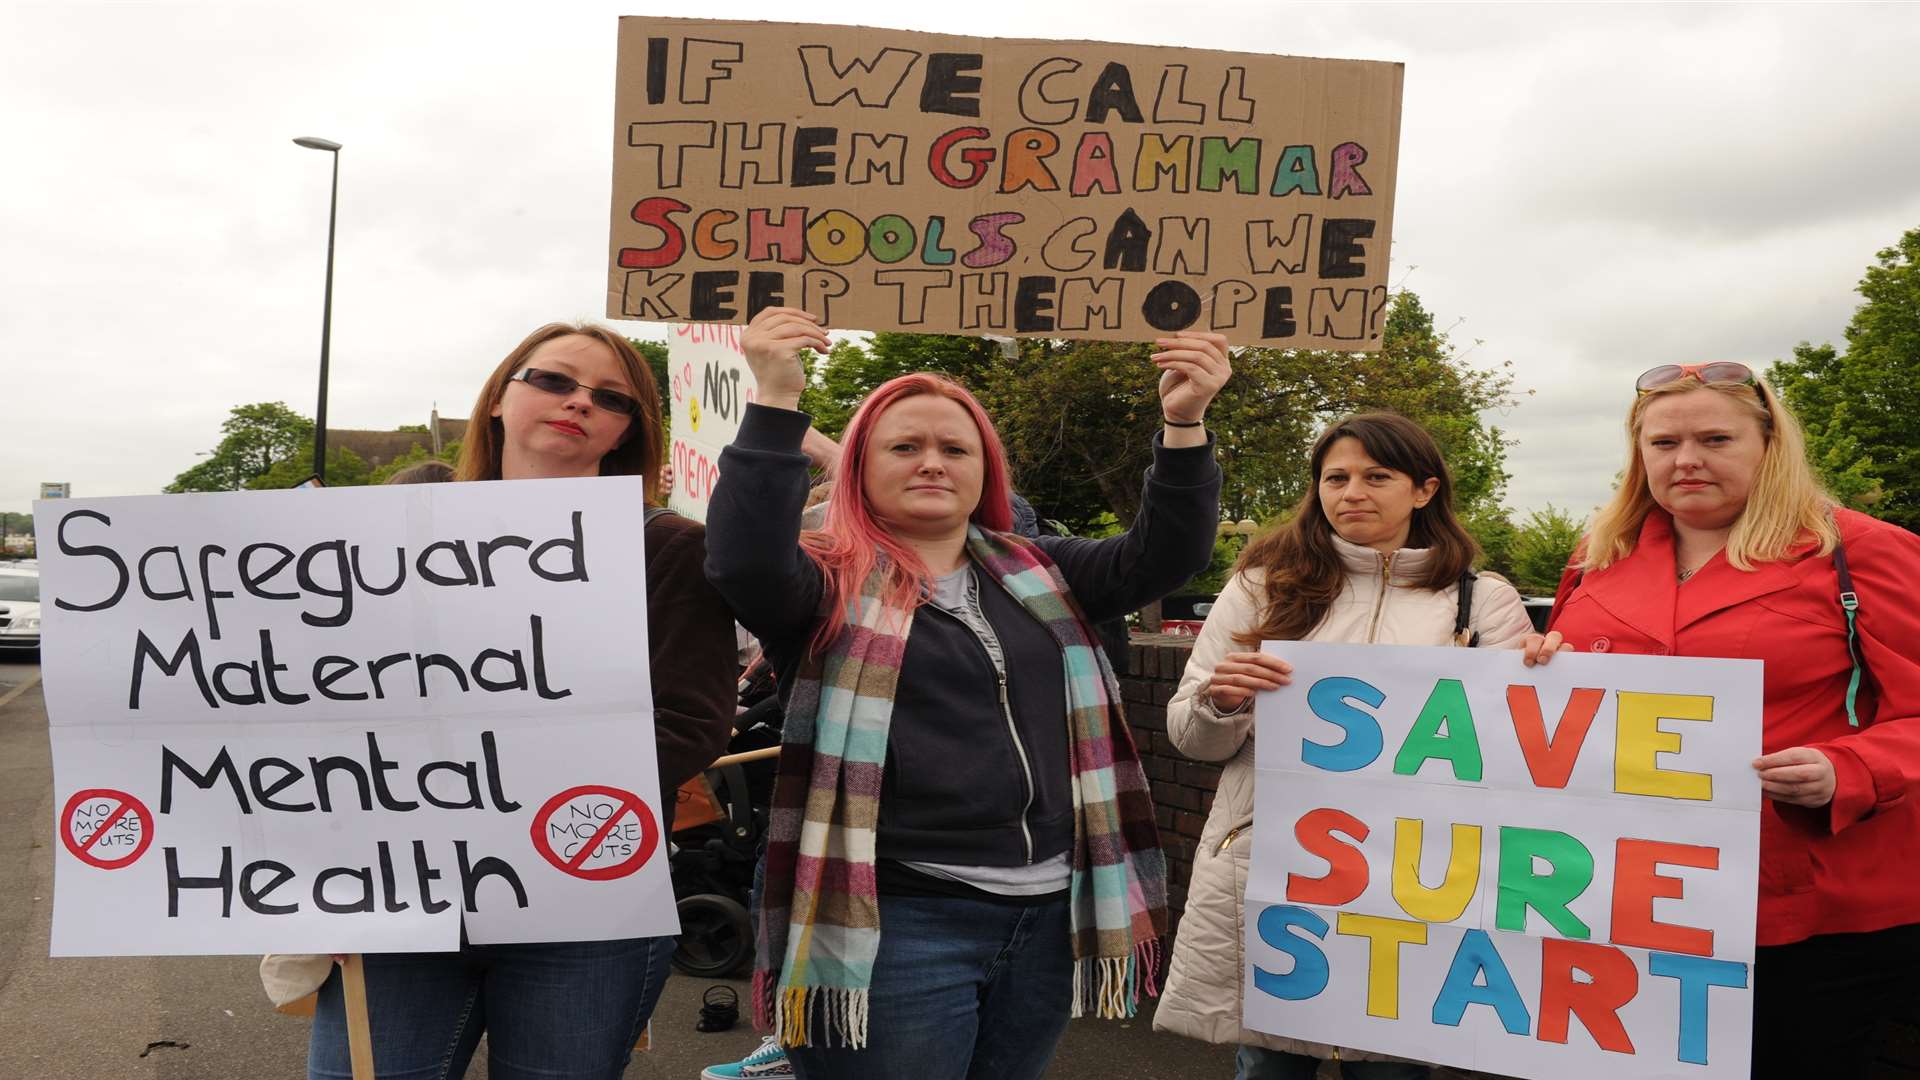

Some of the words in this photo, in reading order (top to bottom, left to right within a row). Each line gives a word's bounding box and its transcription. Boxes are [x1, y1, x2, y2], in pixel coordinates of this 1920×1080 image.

[646, 37, 743, 105] IF
[798, 45, 984, 117] WE
[1018, 57, 1256, 125] CALL
[628, 121, 908, 188] THEM
[928, 127, 1372, 199] GRAMMAR
[1041, 207, 1210, 275] CAN
[1246, 213, 1377, 279] WE
[621, 269, 850, 327] KEEP
[874, 269, 1125, 333] THEM
[1141, 279, 1387, 340] OPEN?
[703, 360, 740, 425] NOT
[55, 510, 589, 640] Safeguard
[129, 614, 572, 709] Maternal
[160, 731, 522, 814] Mental
[1301, 676, 1715, 801] SAVE
[77, 804, 110, 818] NO
[550, 822, 641, 841] MORE
[570, 803, 614, 820] NO
[165, 840, 528, 918] Health
[564, 842, 632, 859] CUTS
[1286, 808, 1720, 957] SURE
[1253, 905, 1748, 1065] START
